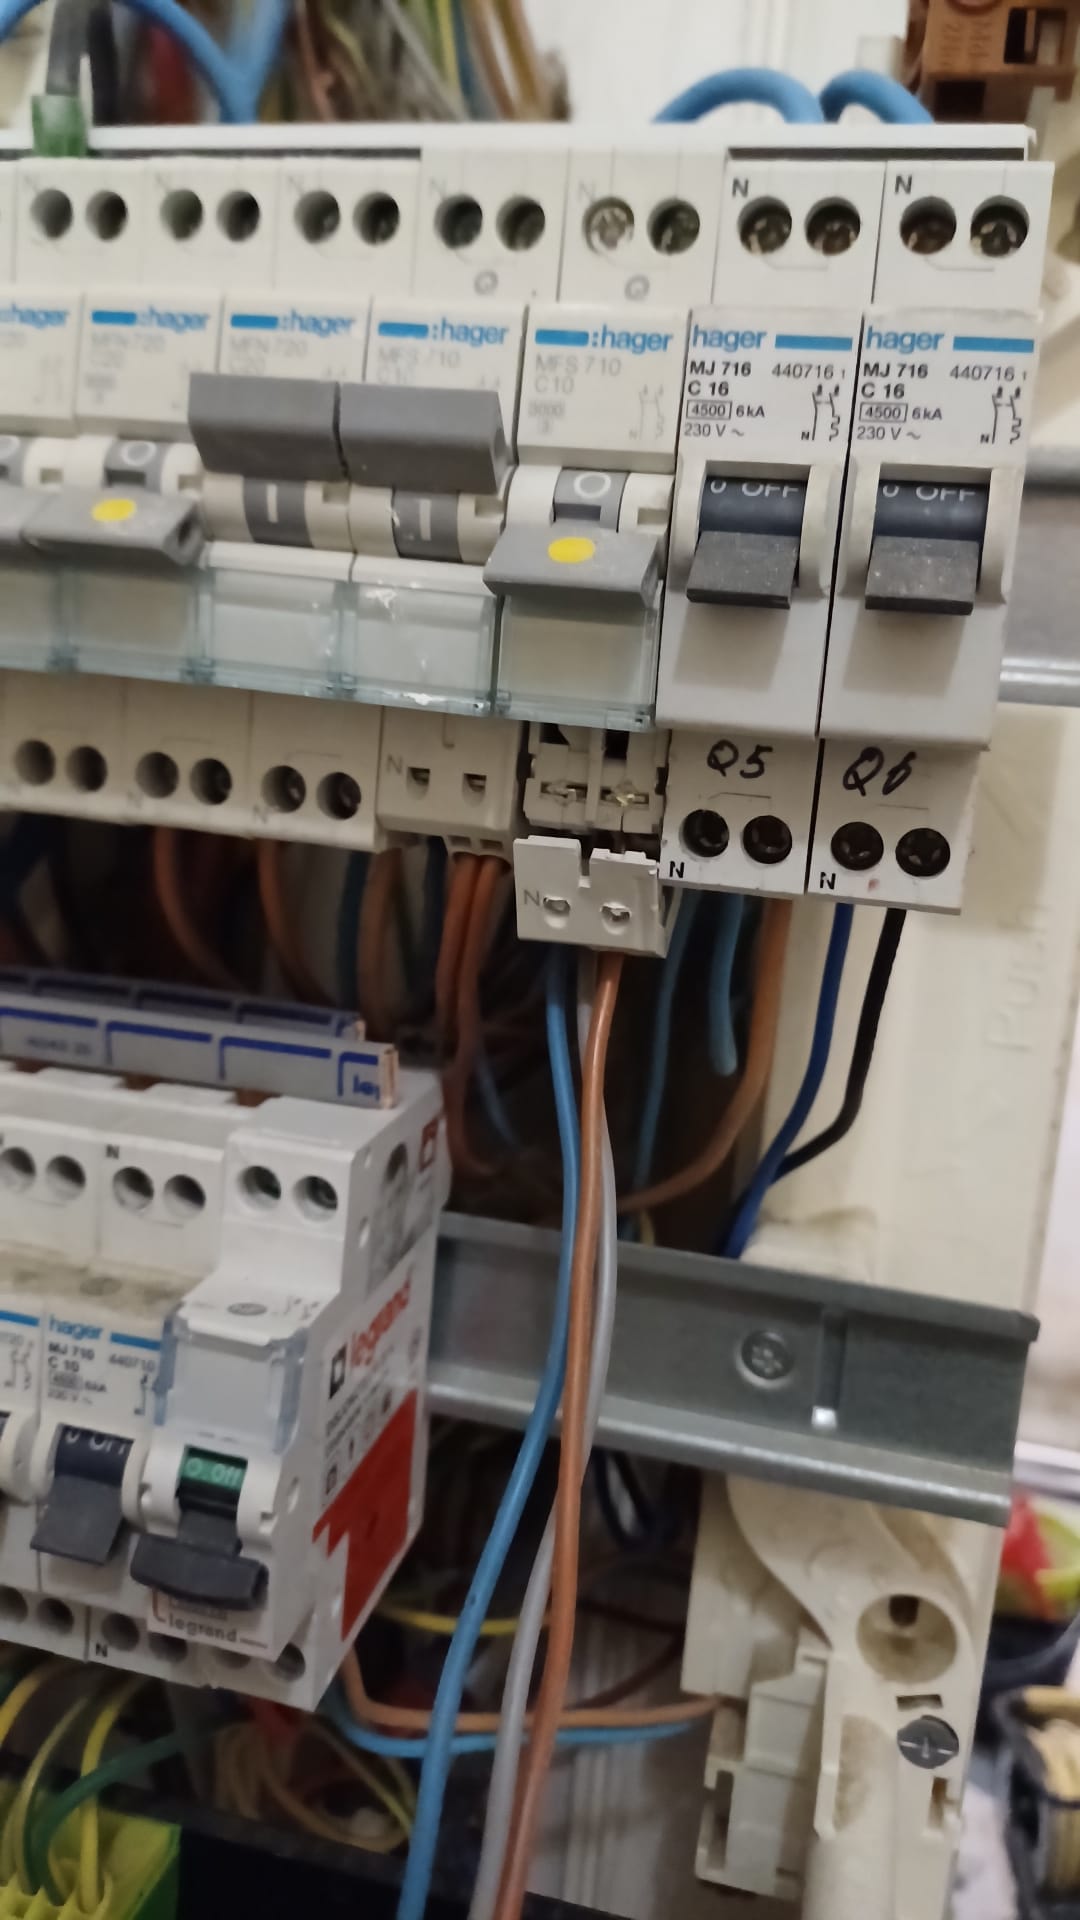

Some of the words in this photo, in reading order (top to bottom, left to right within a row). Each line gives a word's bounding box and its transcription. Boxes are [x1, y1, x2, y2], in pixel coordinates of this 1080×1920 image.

[732, 178, 749, 197] N
[895, 175, 912, 194] N
[692, 325, 767, 353] hager
[866, 327, 944, 355] hager
[535, 354, 579, 373] MFS
[584, 357, 621, 377] 710
[690, 361, 715, 376] MJ
[722, 361, 751, 377] 716
[771, 362, 834, 380] 440716
[863, 363, 890, 378] MJ
[897, 363, 928, 379] 716
[950, 365, 1015, 381] 440716
[688, 382, 701, 396] C
[709, 382, 729, 397] 16
[861, 384, 875, 398] C
[885, 384, 905, 399] 16
[692, 404, 726, 418] 4500
[865, 406, 901, 421] 4500
[684, 423, 710, 438] 230
[715, 424, 727, 437] V
[801, 431, 809, 440] N
[857, 426, 885, 440] 230
[889, 426, 902, 440] V
[981, 434, 990, 443] N
[706, 739, 773, 779] Q5
[843, 746, 917, 797] Q6
[669, 861, 685, 878] N
[820, 872, 836, 889] N
[523, 889, 541, 907] N
[106, 1144, 120, 1159] N
[50, 1314, 103, 1340] hager
[49, 1342, 68, 1355] MJ
[169, 1613, 237, 1643] legrand
[95, 1642, 108, 1658] N
